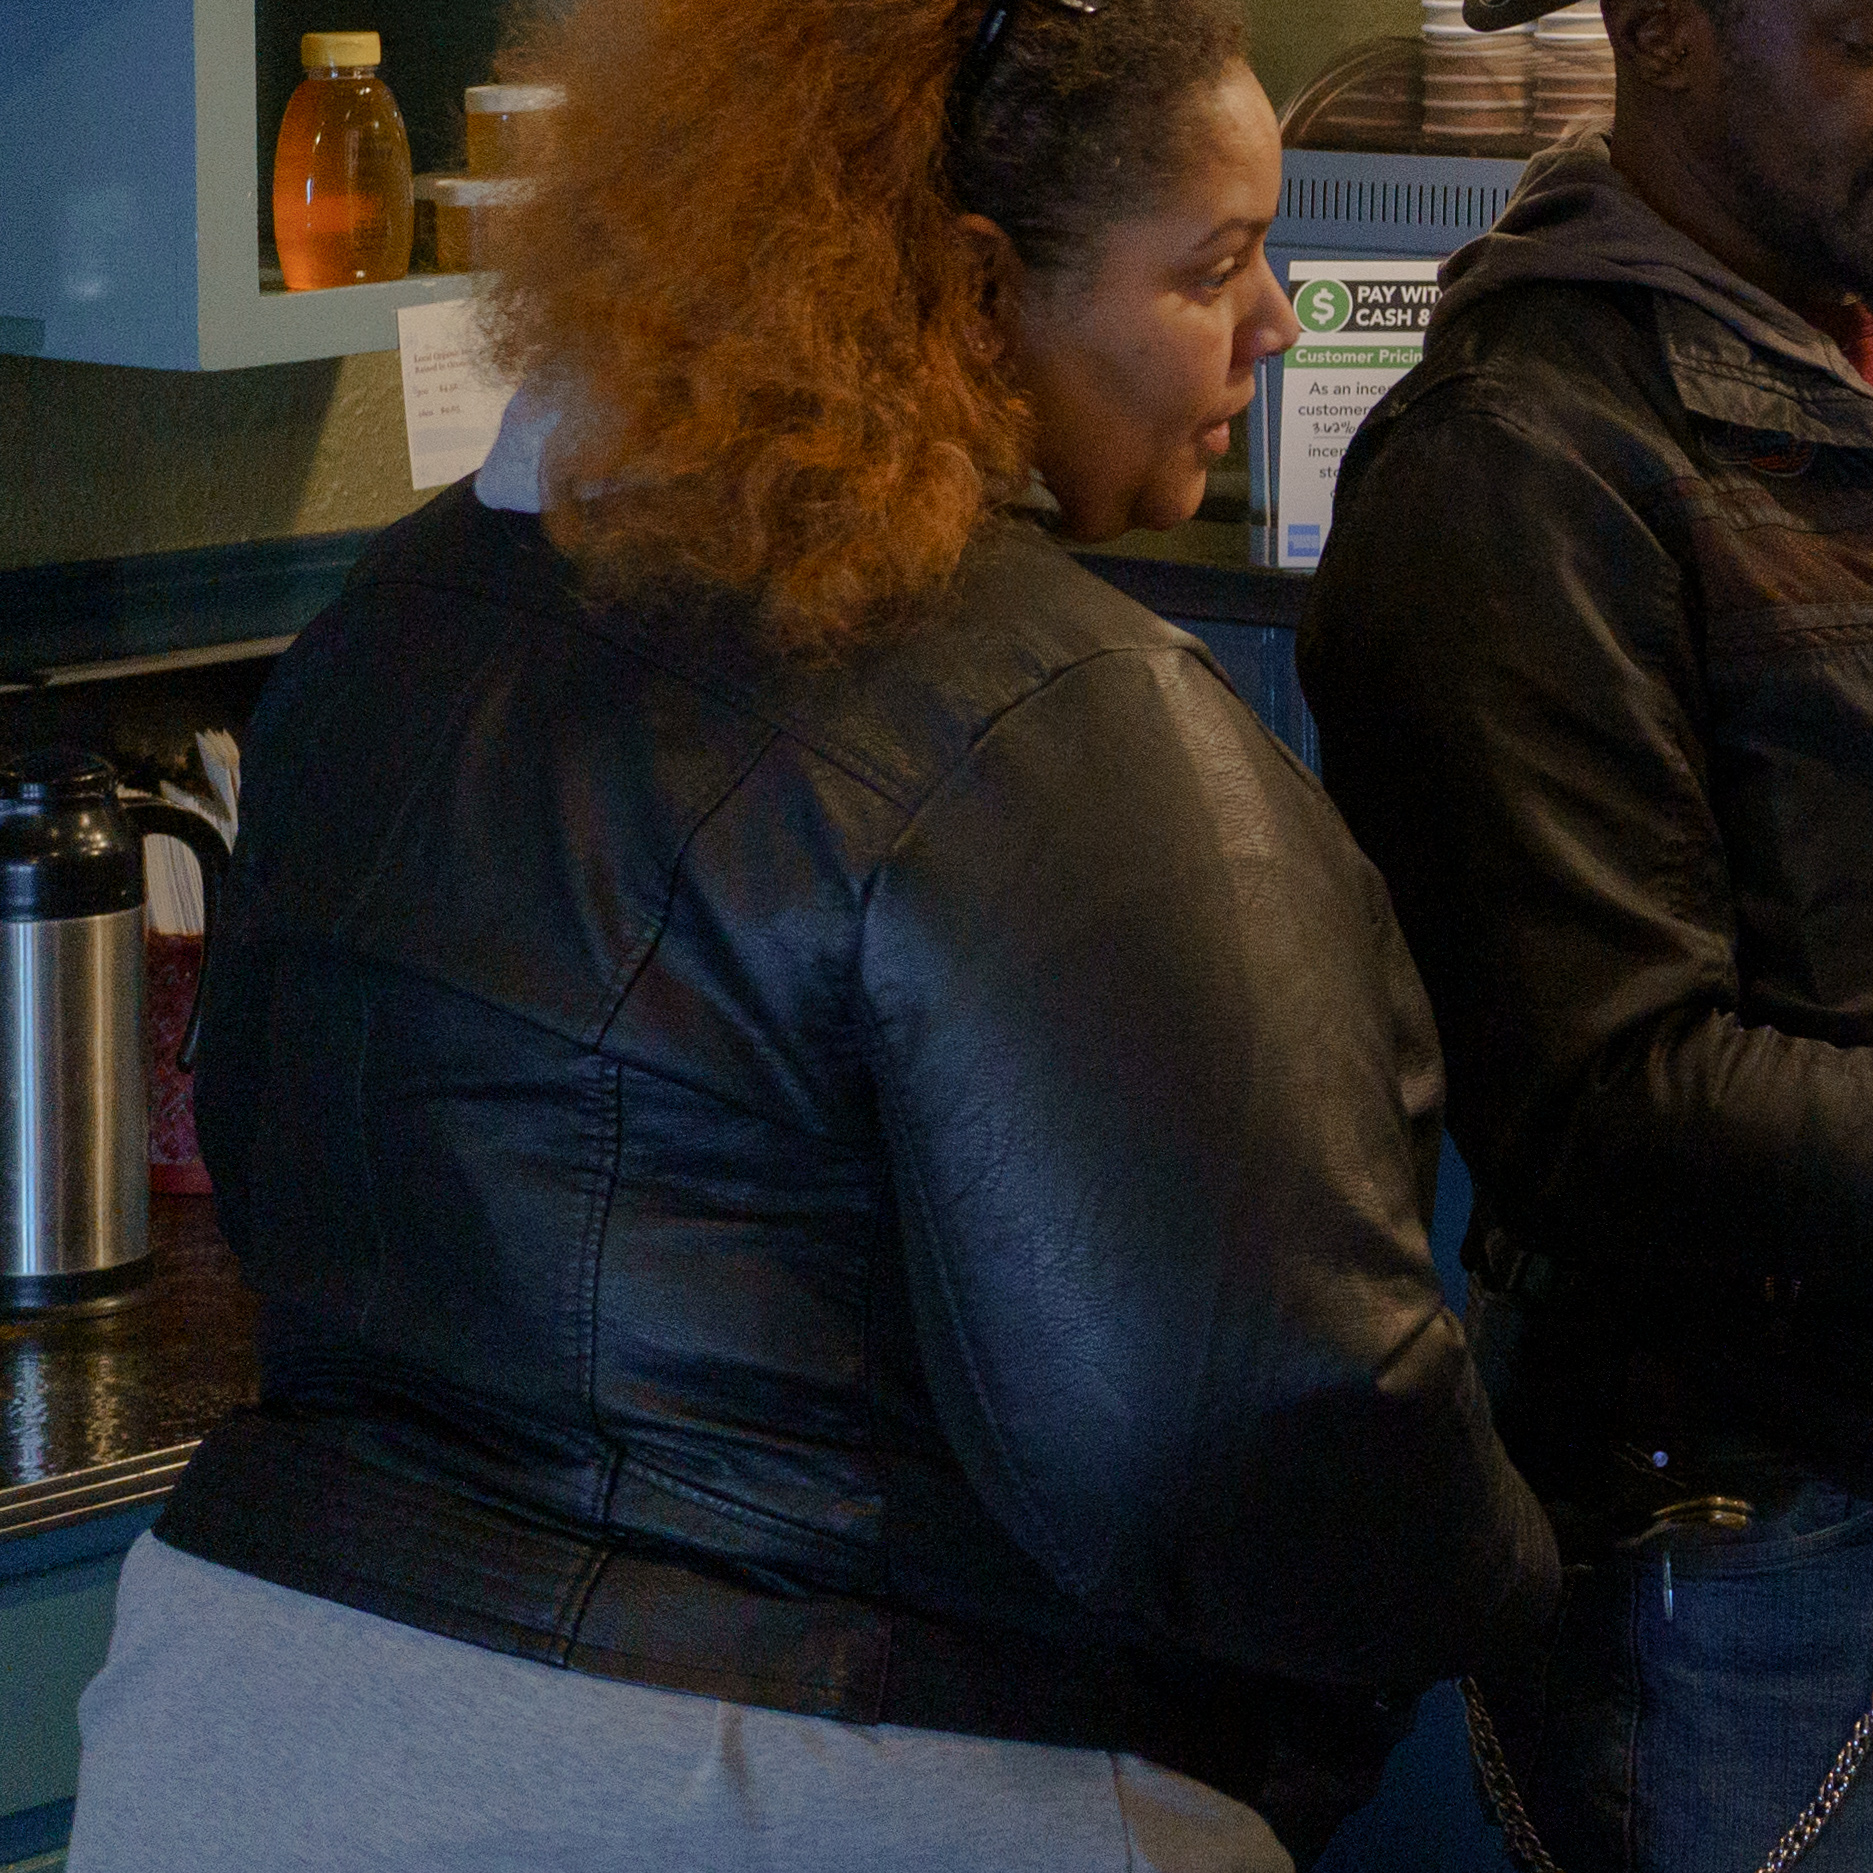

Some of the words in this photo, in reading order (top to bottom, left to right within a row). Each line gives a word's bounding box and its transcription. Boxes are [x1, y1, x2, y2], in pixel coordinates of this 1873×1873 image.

[1357, 285, 1397, 304] PAY
[1400, 285, 1443, 304] WIT
[1355, 308, 1412, 327] CASH
[1417, 308, 1431, 327] &
[1295, 348, 1374, 364] Customer
[1379, 349, 1423, 363] Pricin
[1309, 381, 1330, 395] As
[1333, 385, 1350, 395] an
[1356, 381, 1391, 396] ince
